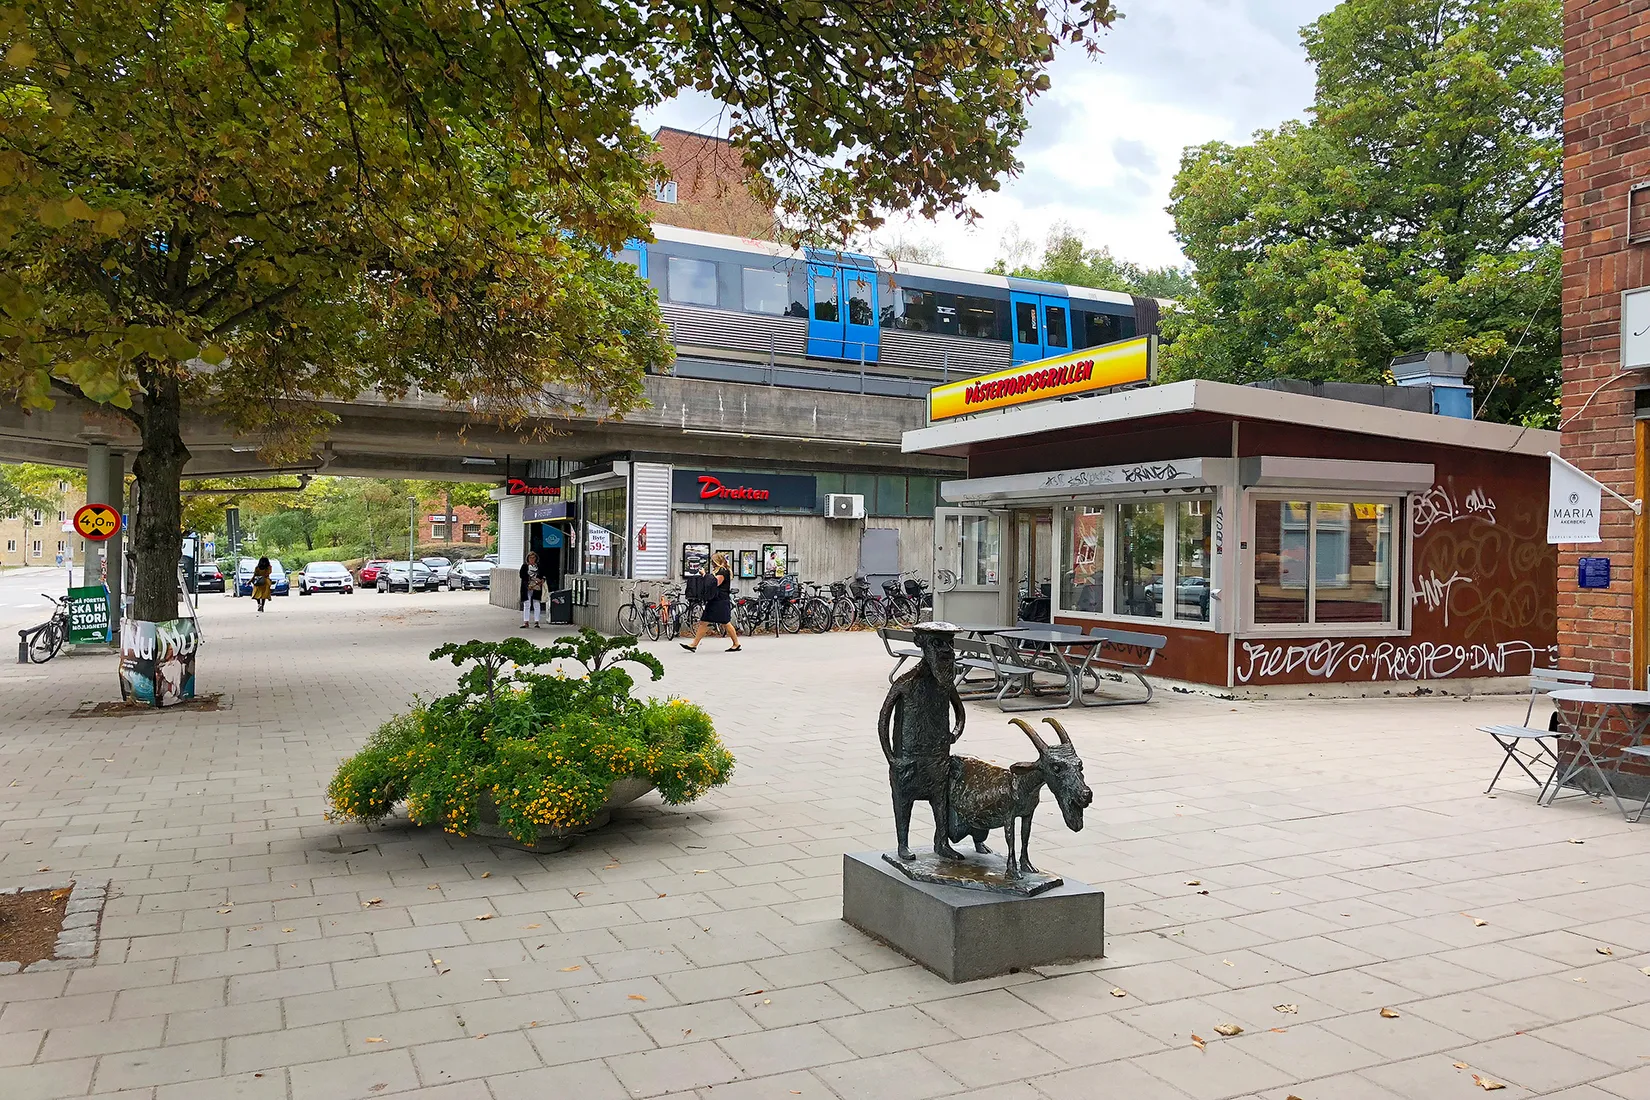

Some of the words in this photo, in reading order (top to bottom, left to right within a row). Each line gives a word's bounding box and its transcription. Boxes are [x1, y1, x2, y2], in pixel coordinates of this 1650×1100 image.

[965, 360, 1094, 405] VÄSTERTORPSGRILLEN
[508, 478, 561, 495] Direkten
[698, 475, 769, 500] Direkten
[1553, 508, 1594, 518] MARIA
[71, 603, 92, 614] SKA
[94, 602, 106, 612] HA
[72, 612, 107, 625] STORA
